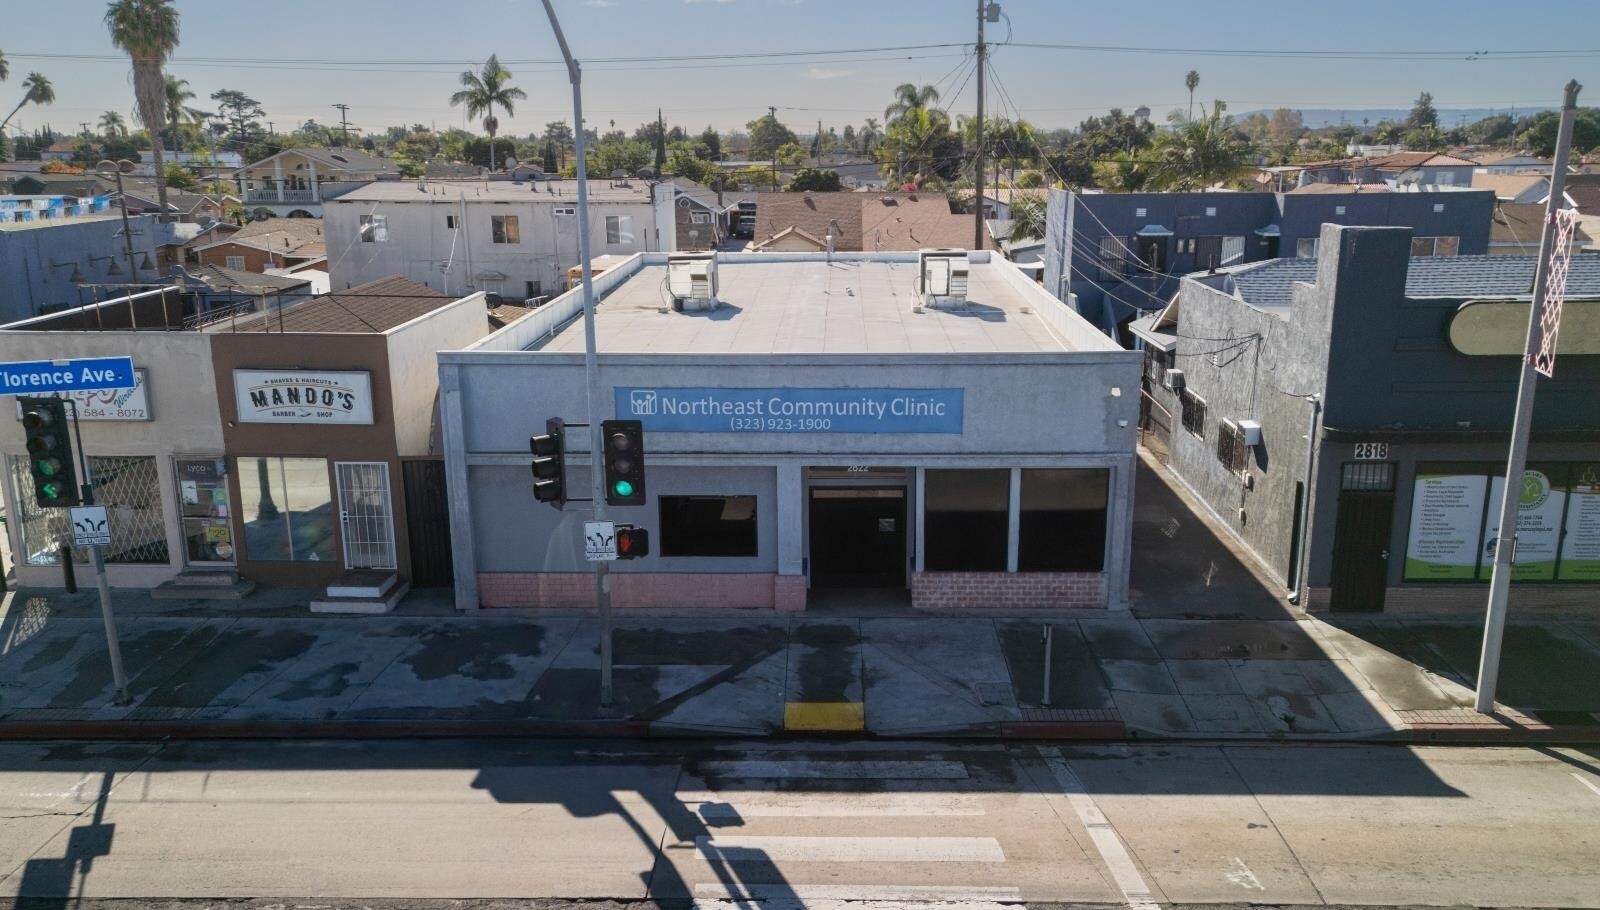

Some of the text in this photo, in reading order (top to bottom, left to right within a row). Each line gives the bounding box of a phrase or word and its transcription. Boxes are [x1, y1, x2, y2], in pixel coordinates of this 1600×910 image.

[0, 370, 74, 387] lorence
[301, 377, 332, 385] HAIRCUTS
[250, 387, 355, 411] MANDO'S
[84, 409, 105, 417] 584
[117, 408, 145, 417] 8072
[662, 396, 945, 420] Northeast Community Clinic
[730, 417, 831, 431] (323) 923-1900
[1356, 443, 1387, 458] 2818
